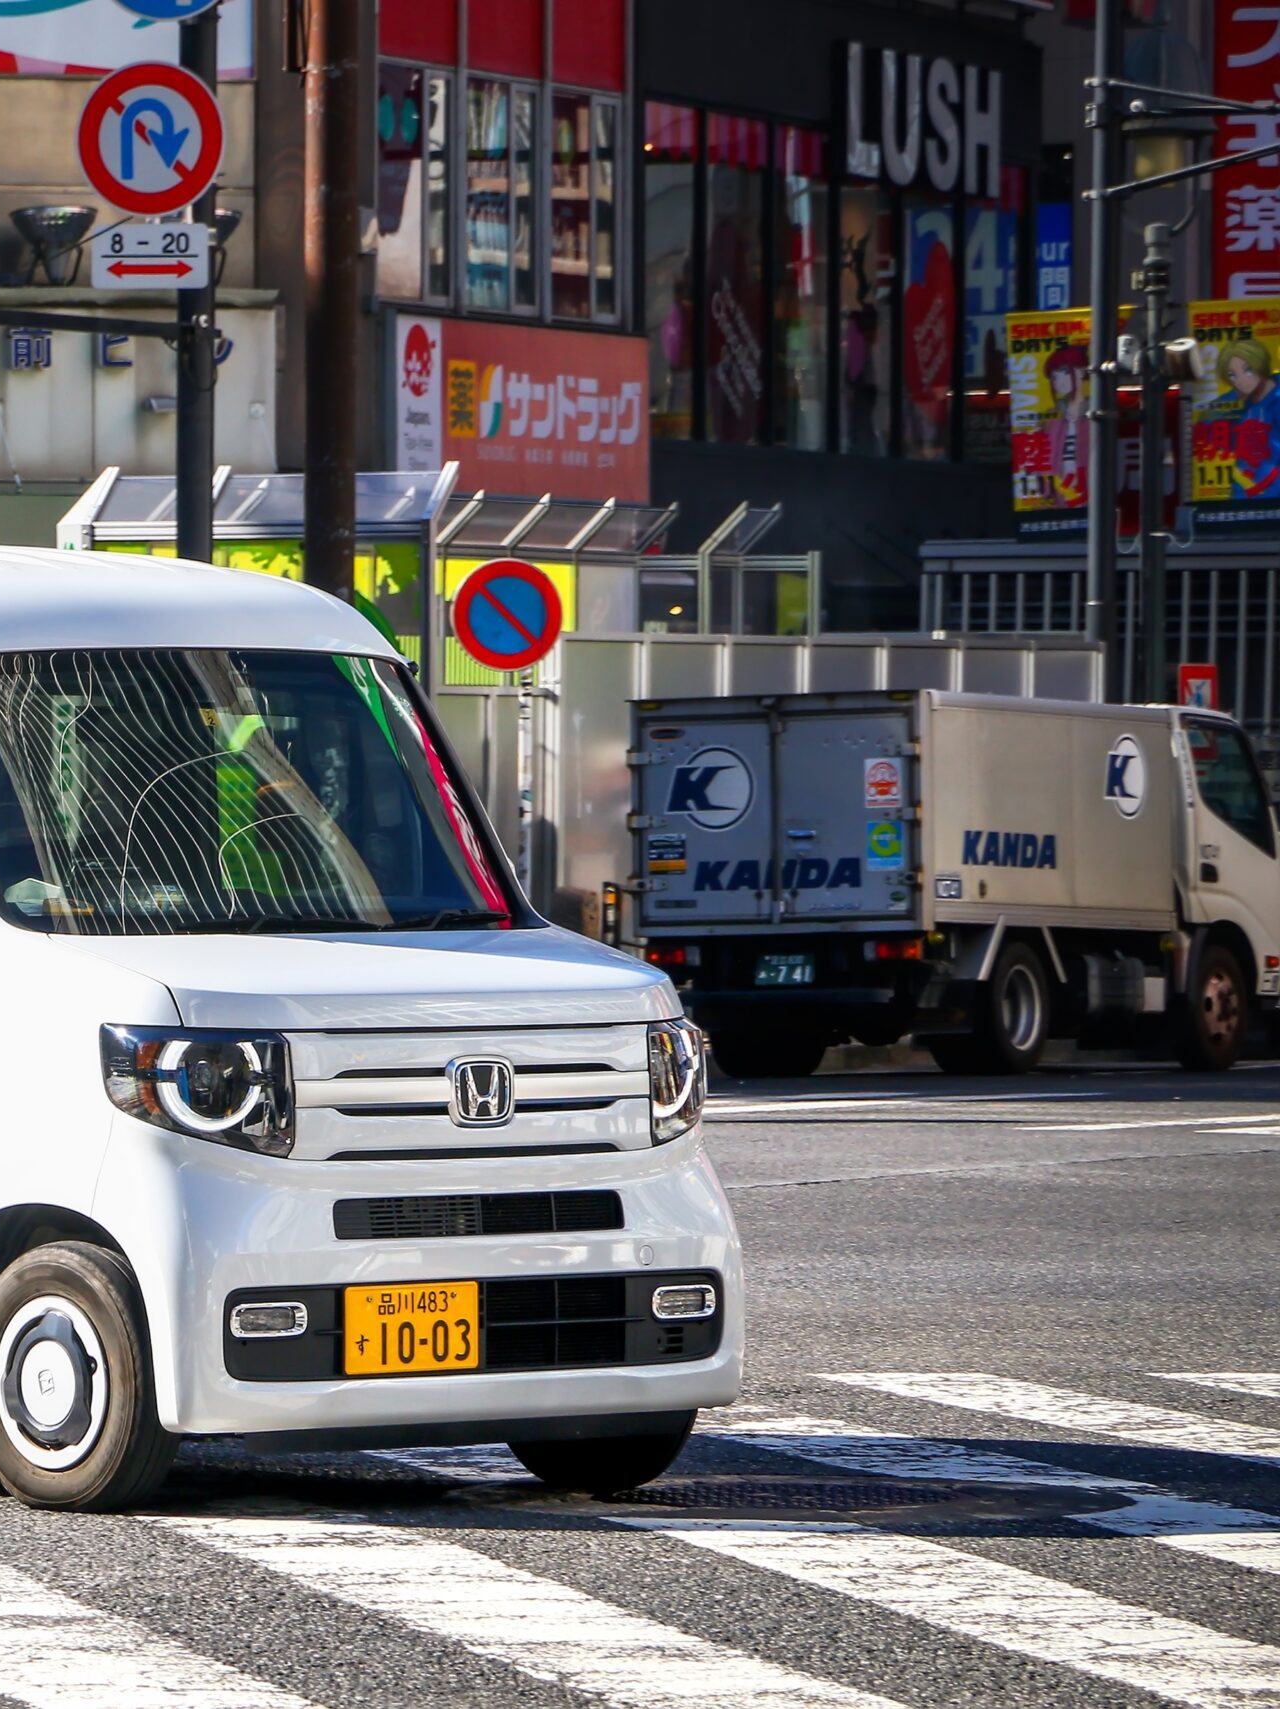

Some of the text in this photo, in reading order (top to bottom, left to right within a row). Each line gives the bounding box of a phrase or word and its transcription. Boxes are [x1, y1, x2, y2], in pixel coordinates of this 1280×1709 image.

[846, 41, 1002, 199] LUSH
[110, 233, 124, 254] 8
[162, 232, 190, 254] 20
[1194, 326, 1253, 343] DAYS
[507, 372, 642, 446] サンドラッグ
[1198, 465, 1233, 487] 1.11
[962, 829, 1057, 869] KANDA
[693, 857, 862, 892] KANDA
[377, 1290, 449, 1316] 品川483
[354, 1318, 472, 1366] す 10-03
